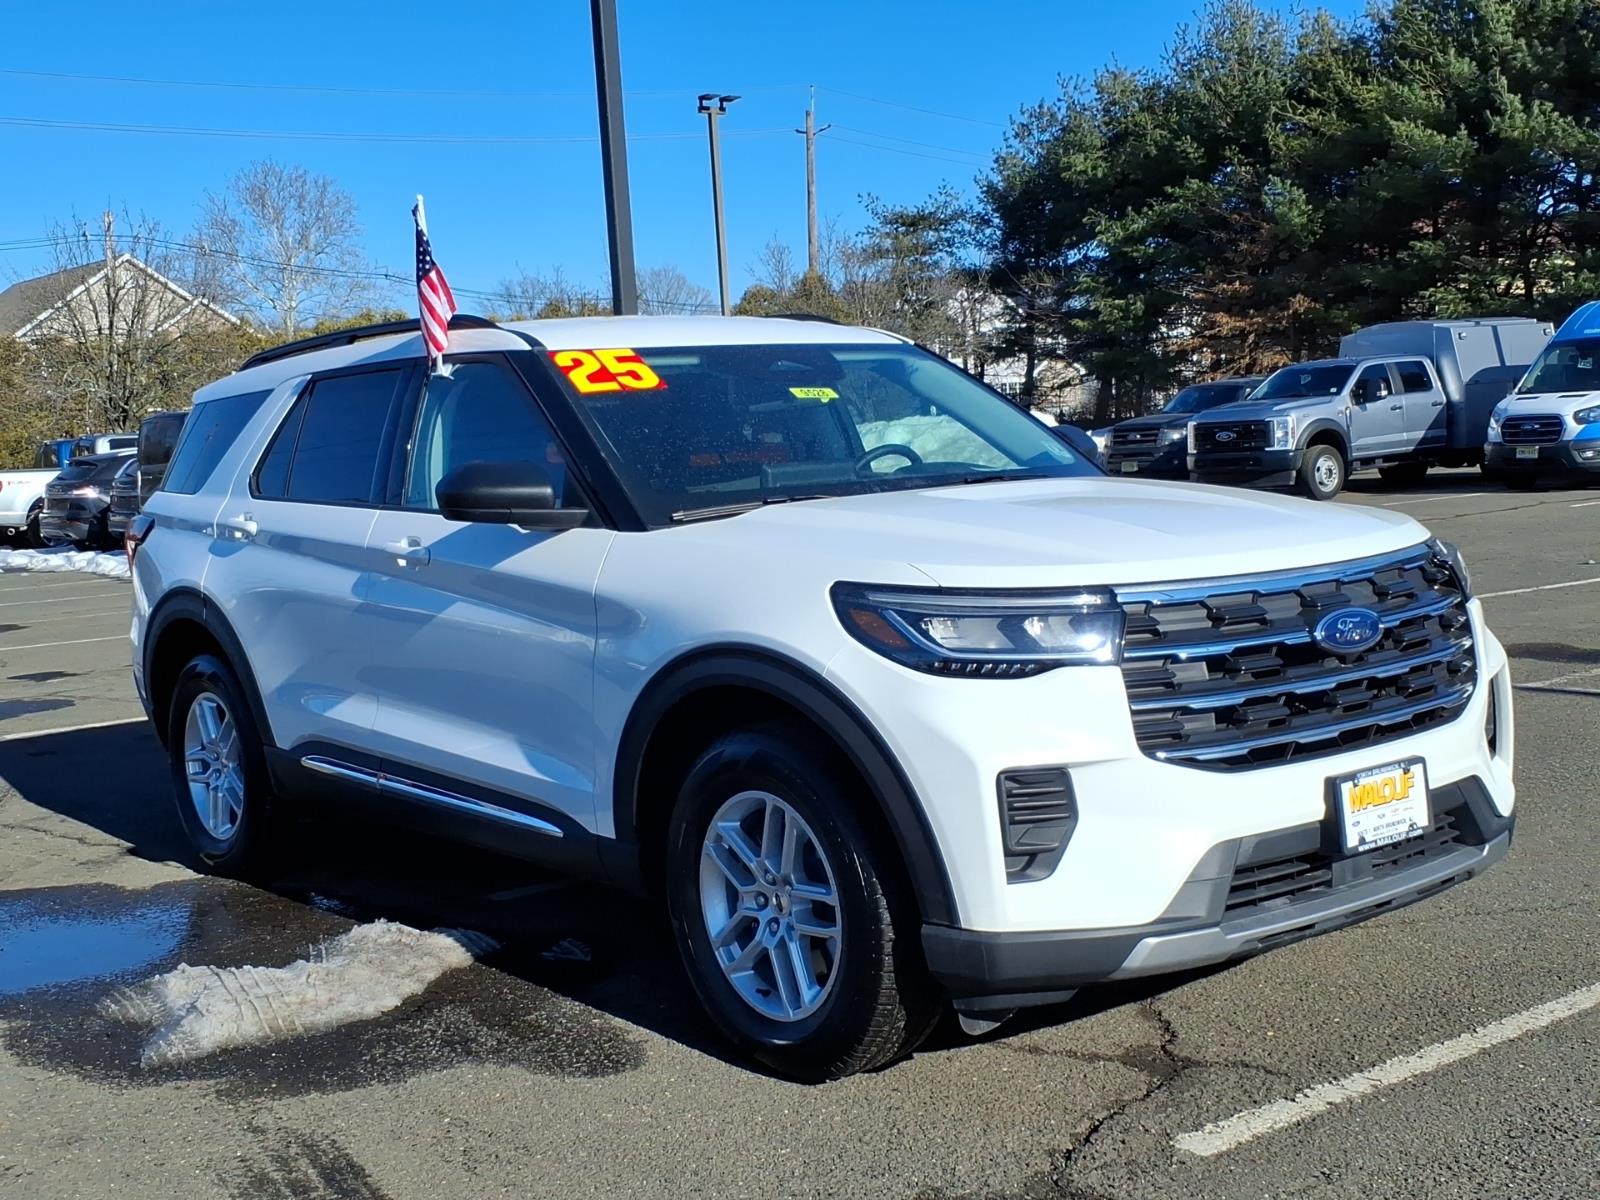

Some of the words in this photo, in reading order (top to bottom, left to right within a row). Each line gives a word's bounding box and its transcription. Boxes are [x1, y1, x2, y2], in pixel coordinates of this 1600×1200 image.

[553, 348, 661, 393] 25
[1336, 616, 1373, 640] Ford
[1349, 772, 1415, 813] MALOUF
